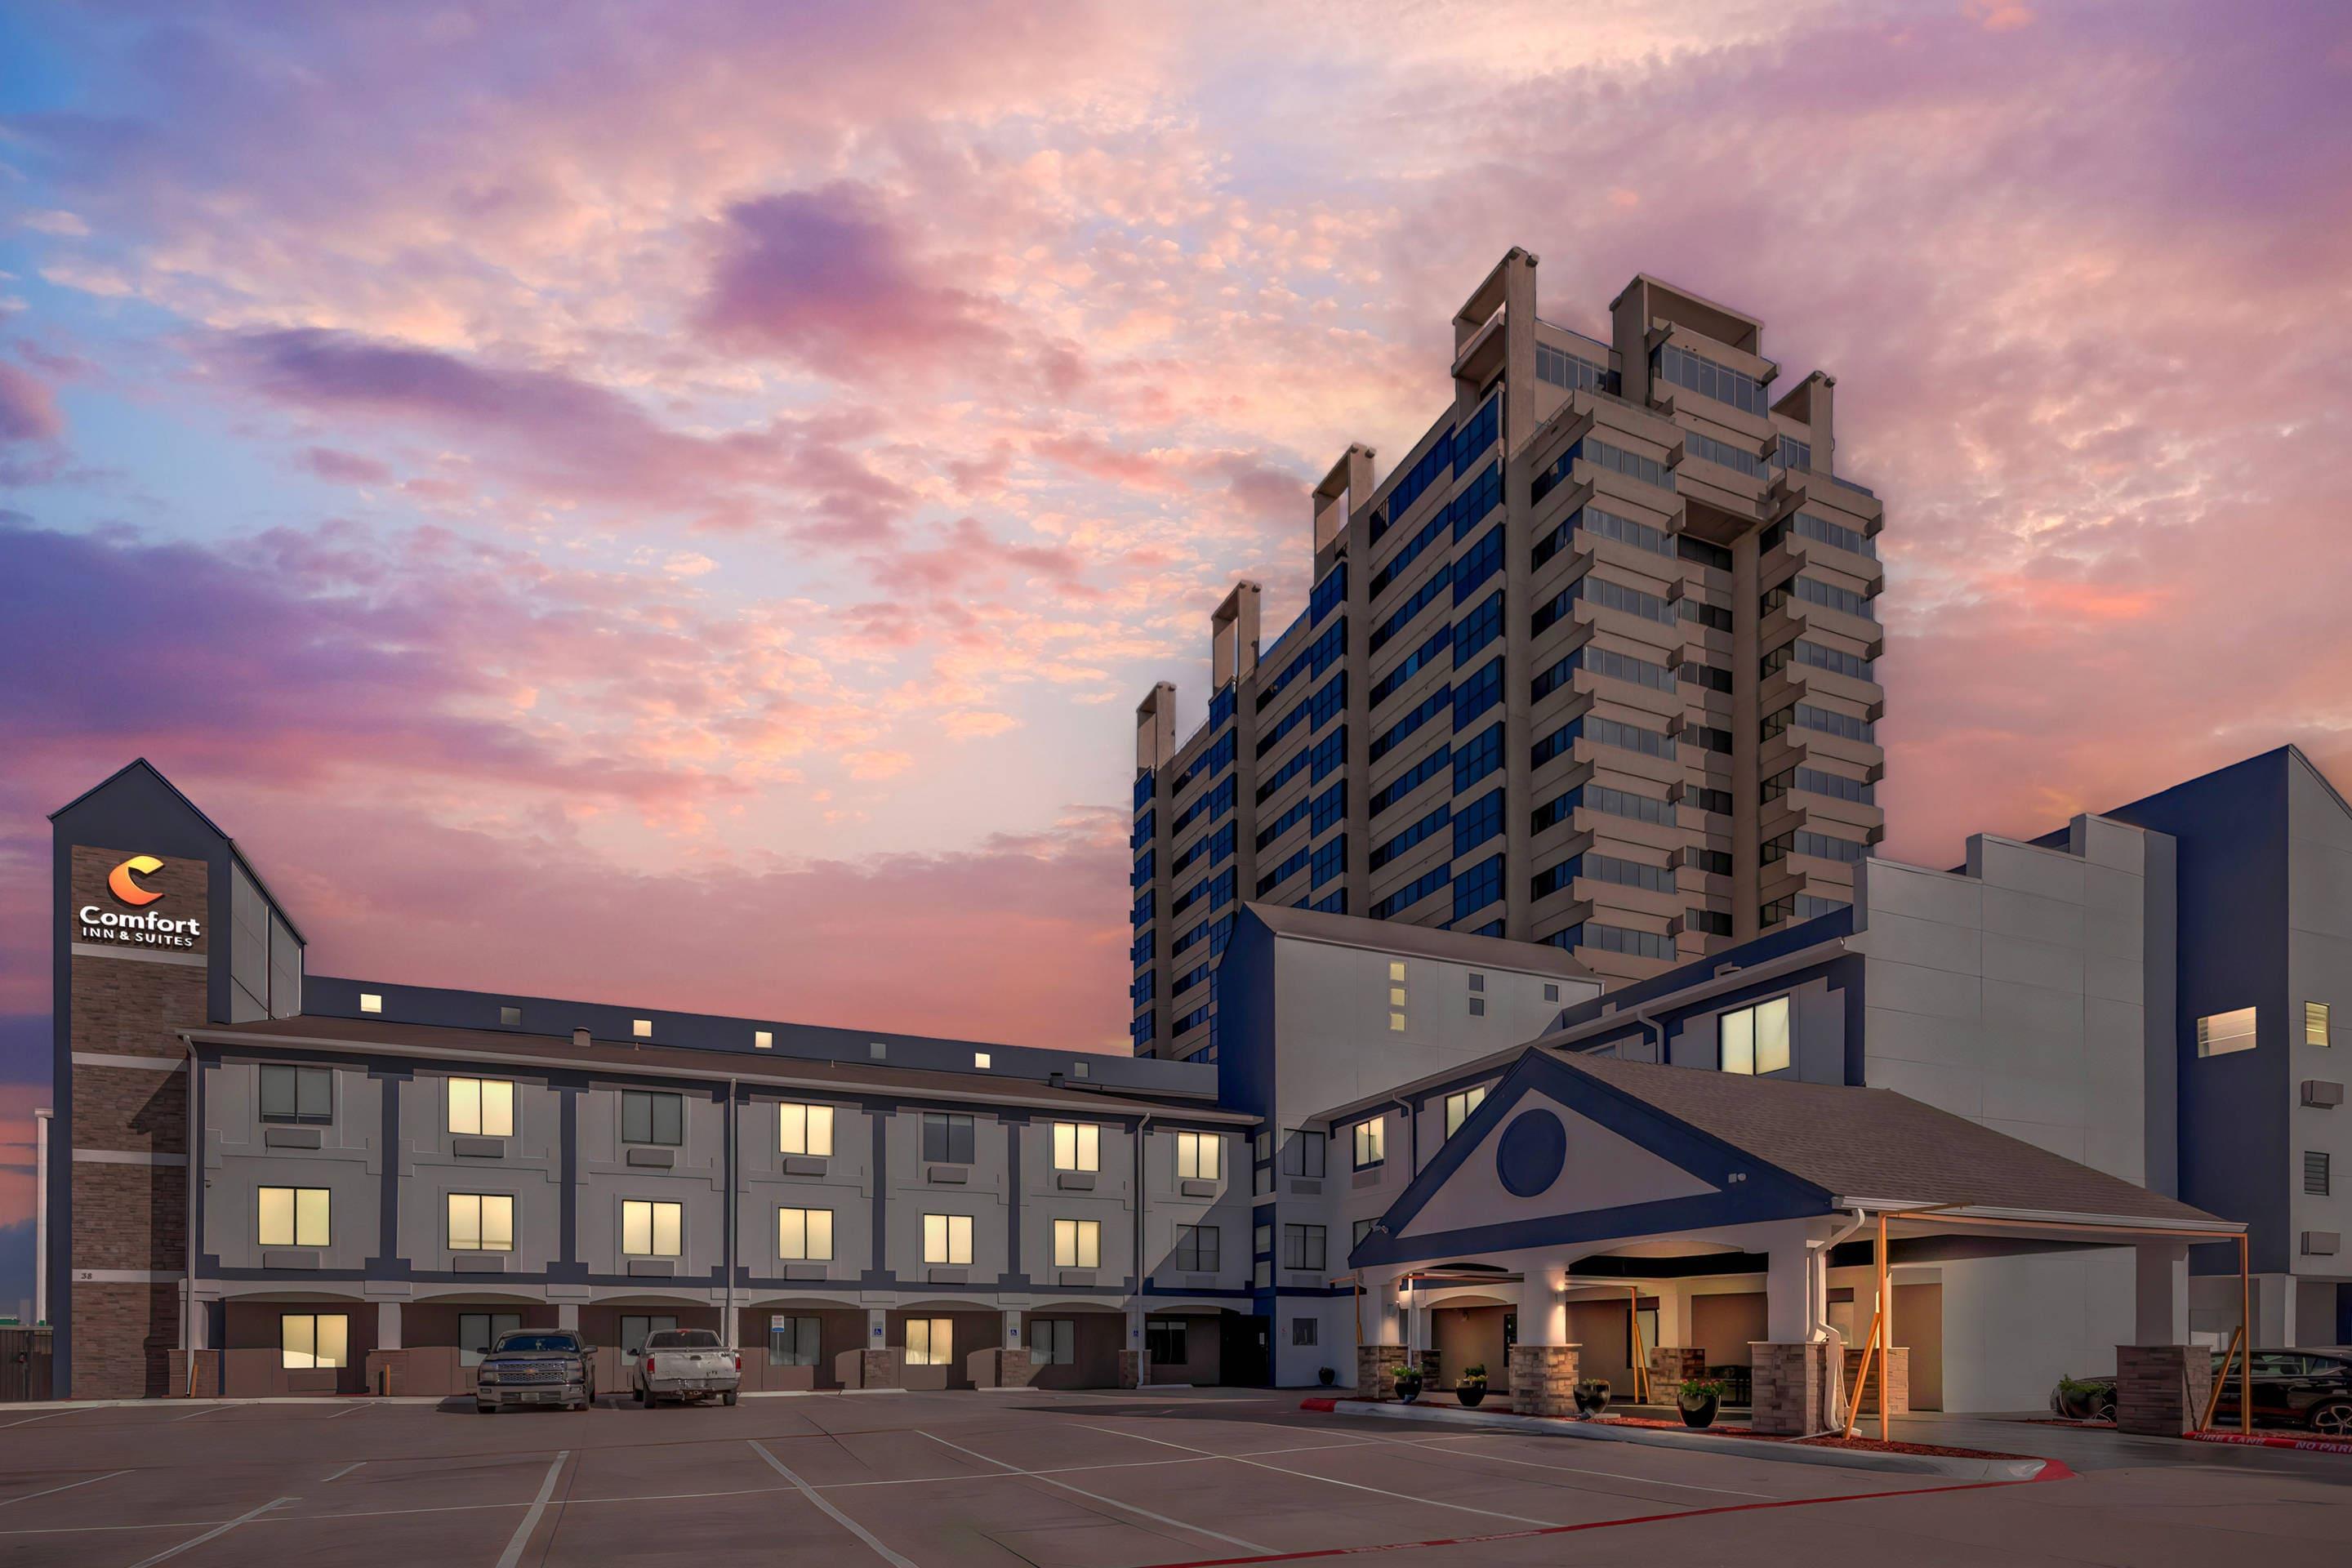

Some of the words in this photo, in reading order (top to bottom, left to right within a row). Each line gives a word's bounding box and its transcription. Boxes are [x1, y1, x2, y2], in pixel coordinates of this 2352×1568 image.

[79, 905, 201, 936] Comfort
[82, 927, 114, 938] INN
[119, 931, 131, 941] &
[135, 933, 193, 947] SUITES
[2227, 1435, 2266, 1446] LANE
[2295, 1441, 2317, 1450] NO
